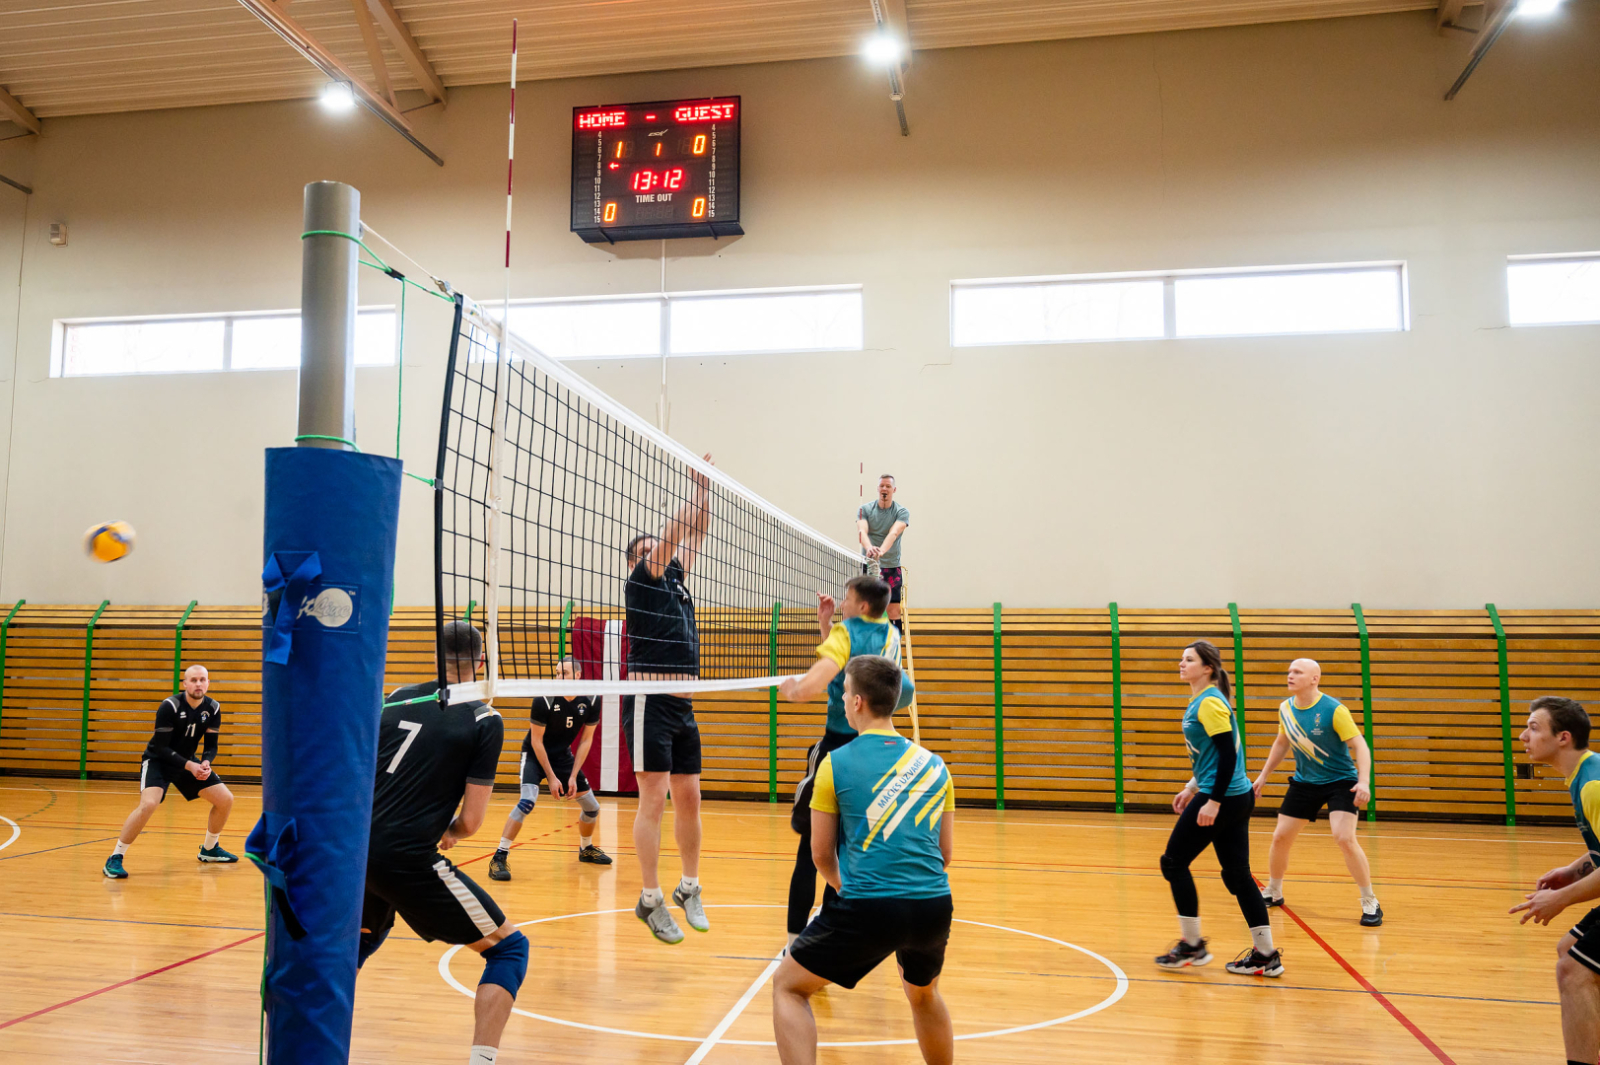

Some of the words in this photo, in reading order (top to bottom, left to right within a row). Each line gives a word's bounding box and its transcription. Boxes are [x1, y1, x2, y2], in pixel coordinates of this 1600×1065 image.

[578, 111, 625, 128] HOME
[675, 104, 734, 121] GUEST
[616, 140, 623, 158] 1
[655, 142, 662, 156] 1
[693, 134, 706, 154] 0
[633, 169, 682, 190] 13:12
[635, 194, 655, 203] TIME
[657, 193, 673, 202] OUT
[692, 198, 705, 217] 0
[603, 203, 616, 222] 0
[184, 722, 197, 738] 11
[565, 716, 574, 729] 5
[386, 720, 423, 774] 7
